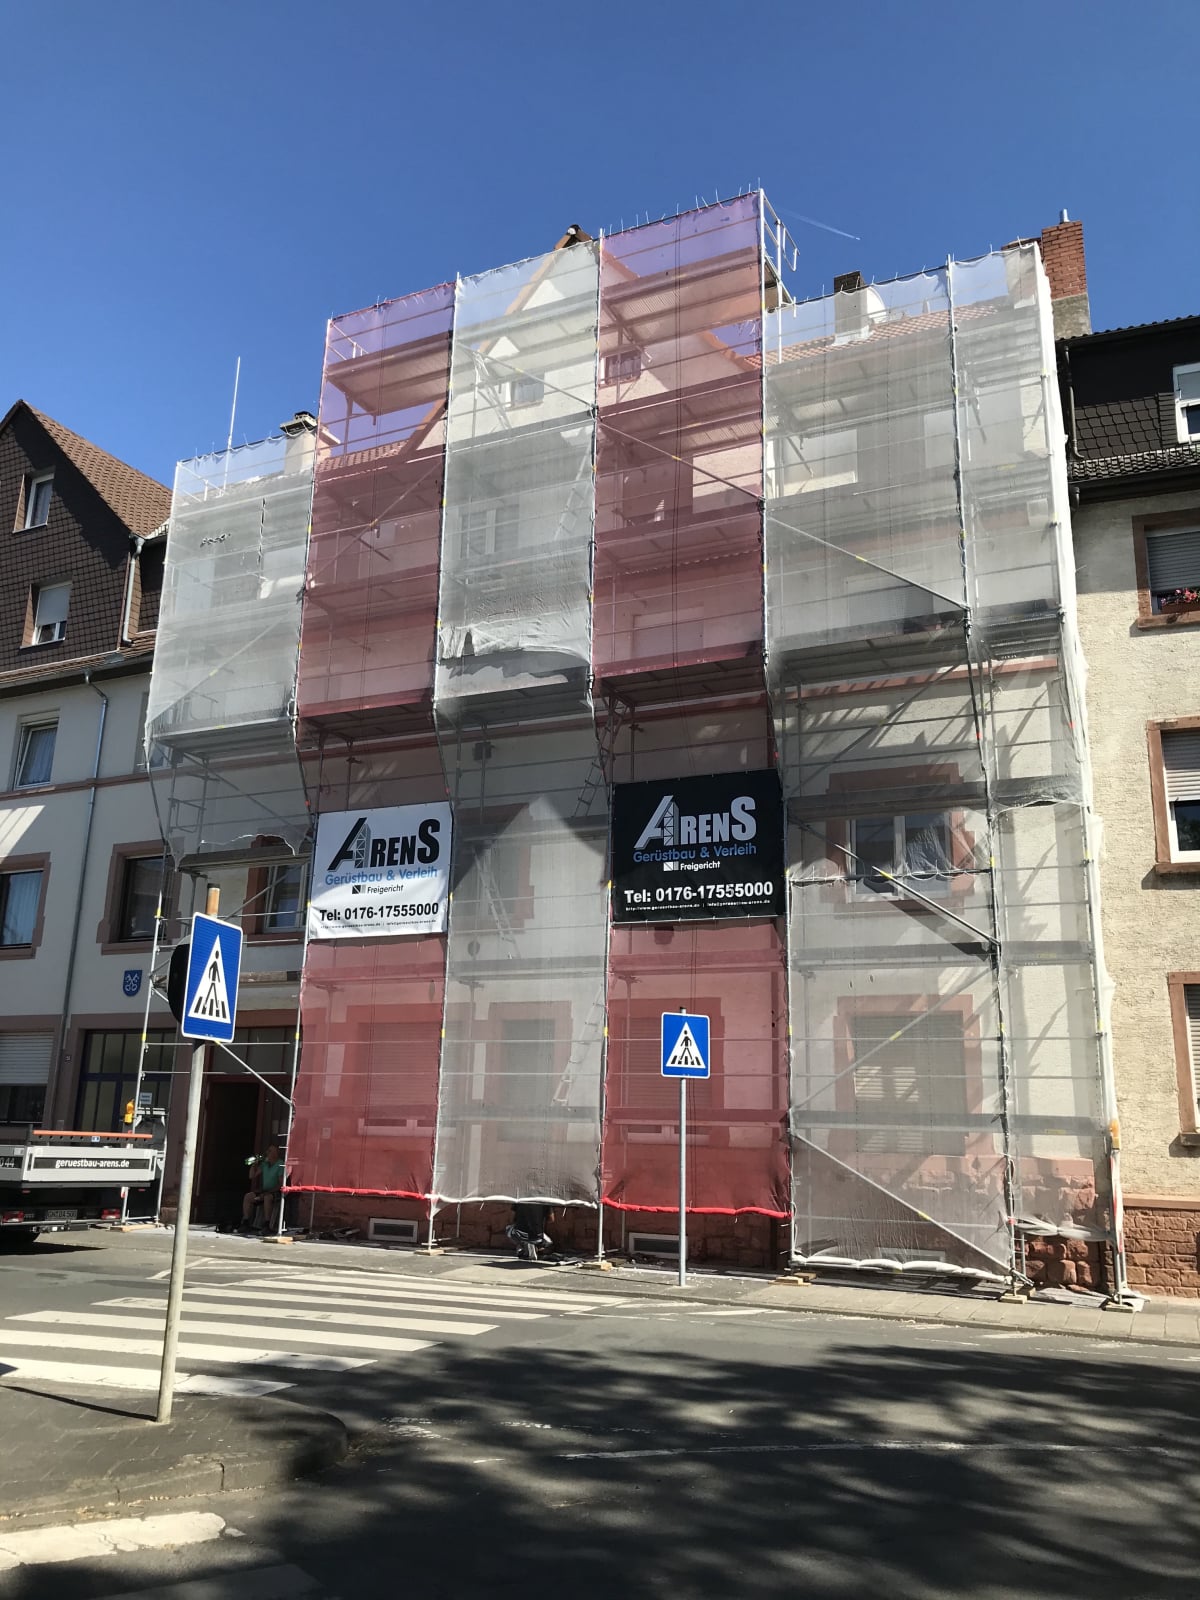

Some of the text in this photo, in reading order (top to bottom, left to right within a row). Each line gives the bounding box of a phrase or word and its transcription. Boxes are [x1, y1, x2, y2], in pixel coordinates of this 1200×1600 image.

[633, 843, 757, 863] Gerüstbau & Verleih
[680, 860, 721, 872] Freigericht
[325, 866, 438, 886] Gerüstbau & Verleih
[367, 884, 404, 895] Freigericht
[624, 881, 773, 903] Tel: 0176-17555000
[319, 902, 439, 921] Tel: 0176-17555000
[55, 1158, 130, 1169] geruestbau-arens.de
